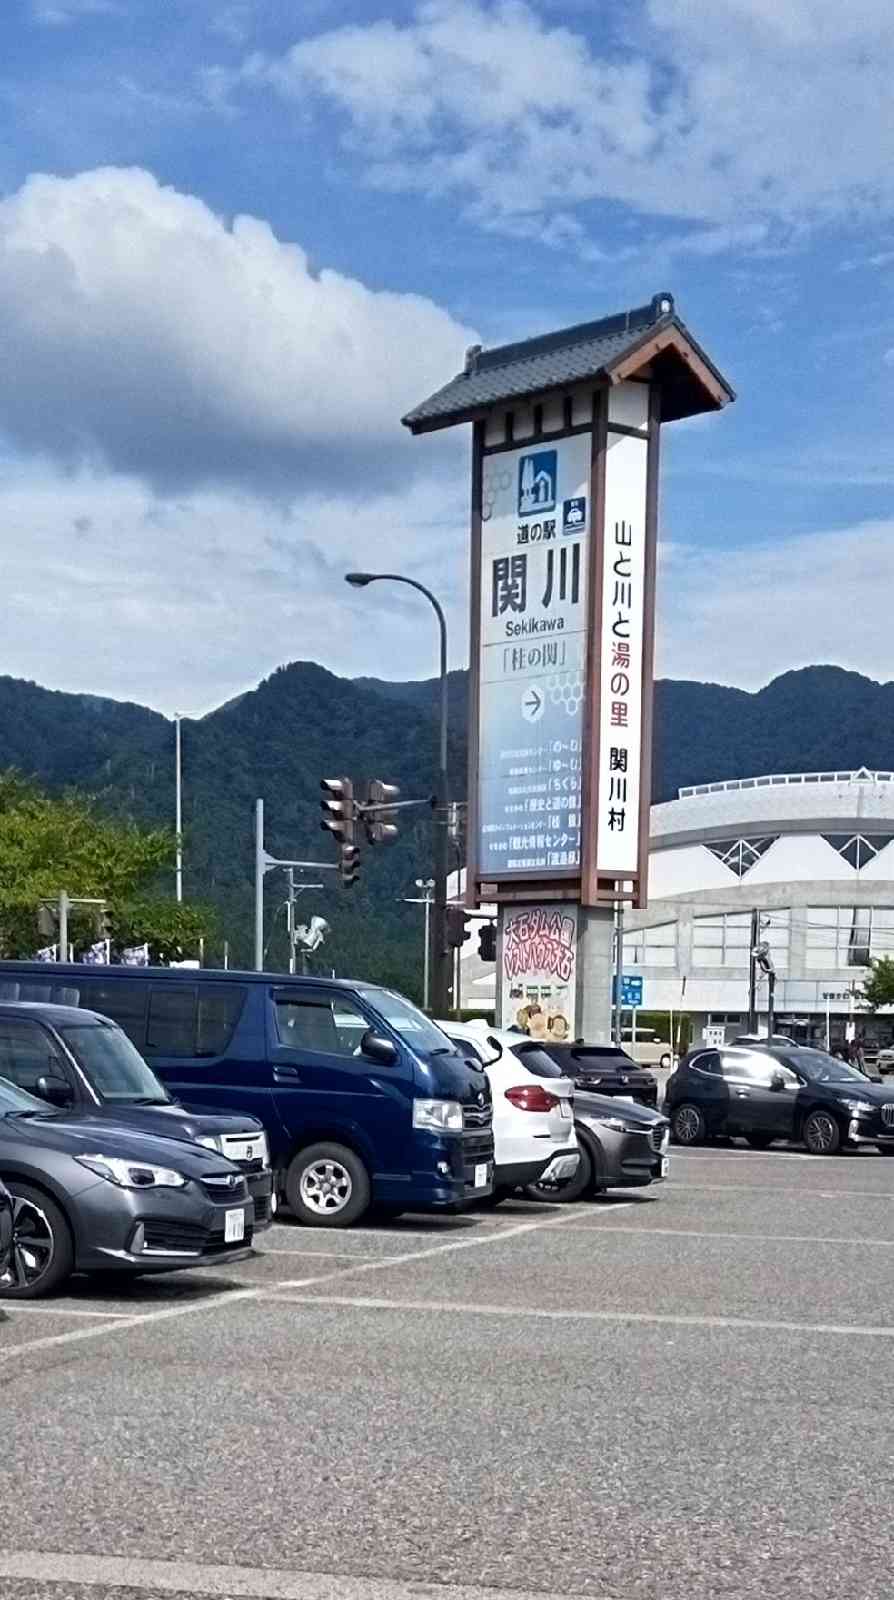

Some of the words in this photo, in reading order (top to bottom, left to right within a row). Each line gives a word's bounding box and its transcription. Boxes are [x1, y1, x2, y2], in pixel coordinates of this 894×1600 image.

[517, 519, 556, 544] 道の駅
[492, 543, 580, 617] 関川
[505, 617, 565, 637] Sekikawa
[611, 520, 632, 728] 山と川と湯の里
[607, 747, 628, 832] 関川村
